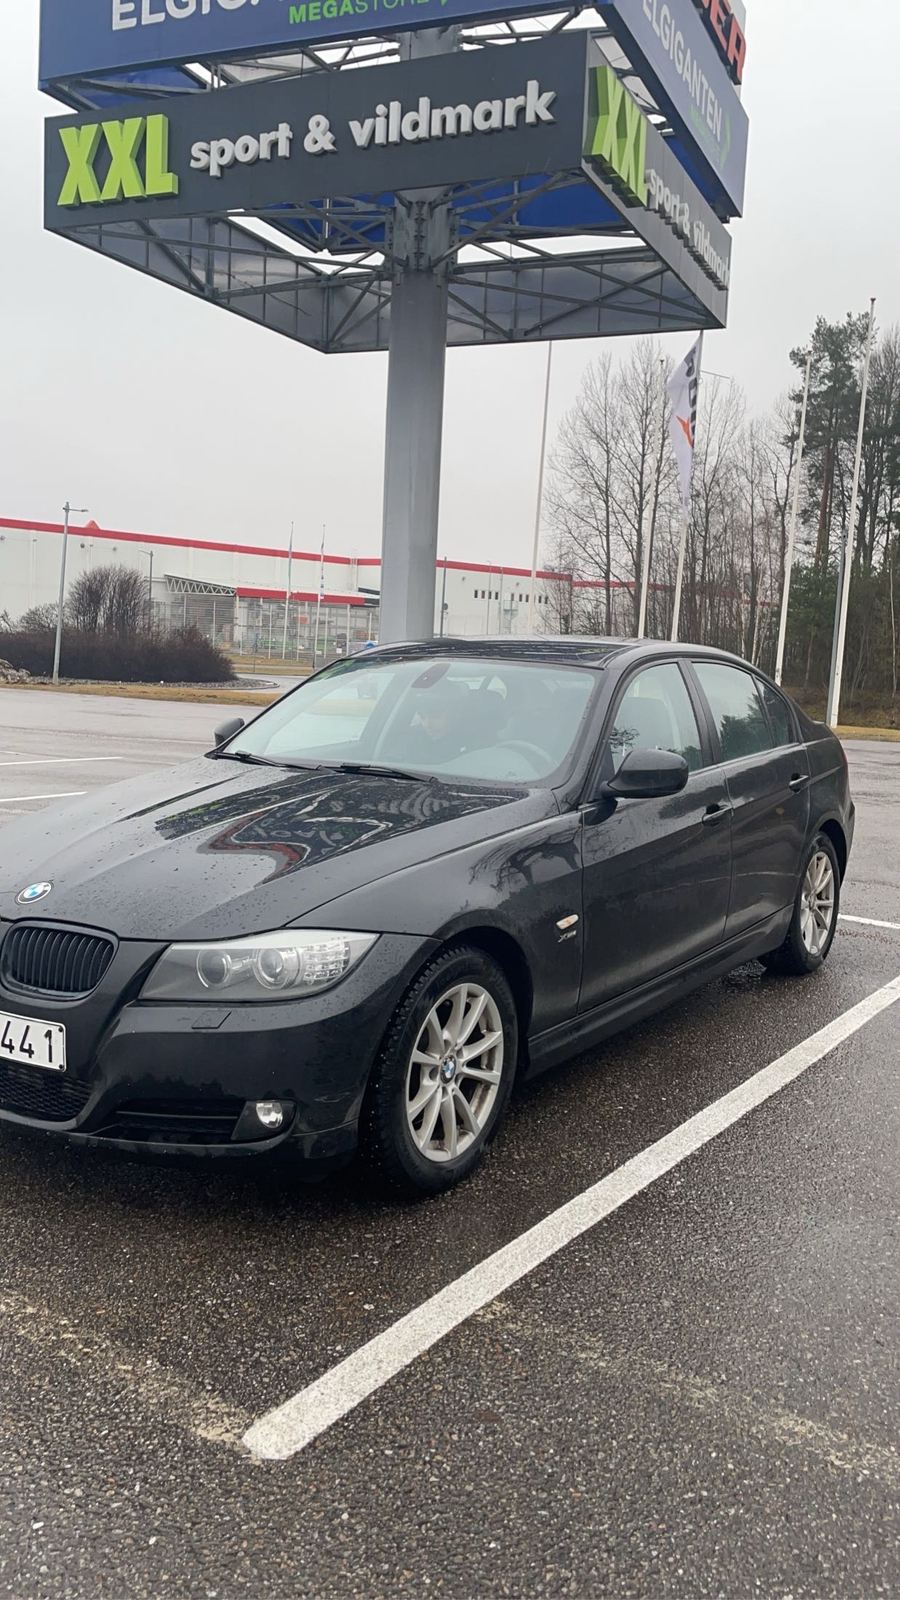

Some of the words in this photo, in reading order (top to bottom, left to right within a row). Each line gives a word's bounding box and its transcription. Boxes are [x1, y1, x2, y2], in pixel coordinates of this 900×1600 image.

[289, 0, 429, 24] MEGAST
[702, 0, 746, 81] ER
[57, 114, 178, 206] XXL
[190, 123, 293, 177] sport
[304, 114, 337, 154] &
[349, 80, 557, 148] vildmark
[592, 65, 648, 207] XXL
[647, 169, 680, 224] sport
[1, 1021, 53, 1063] 441
